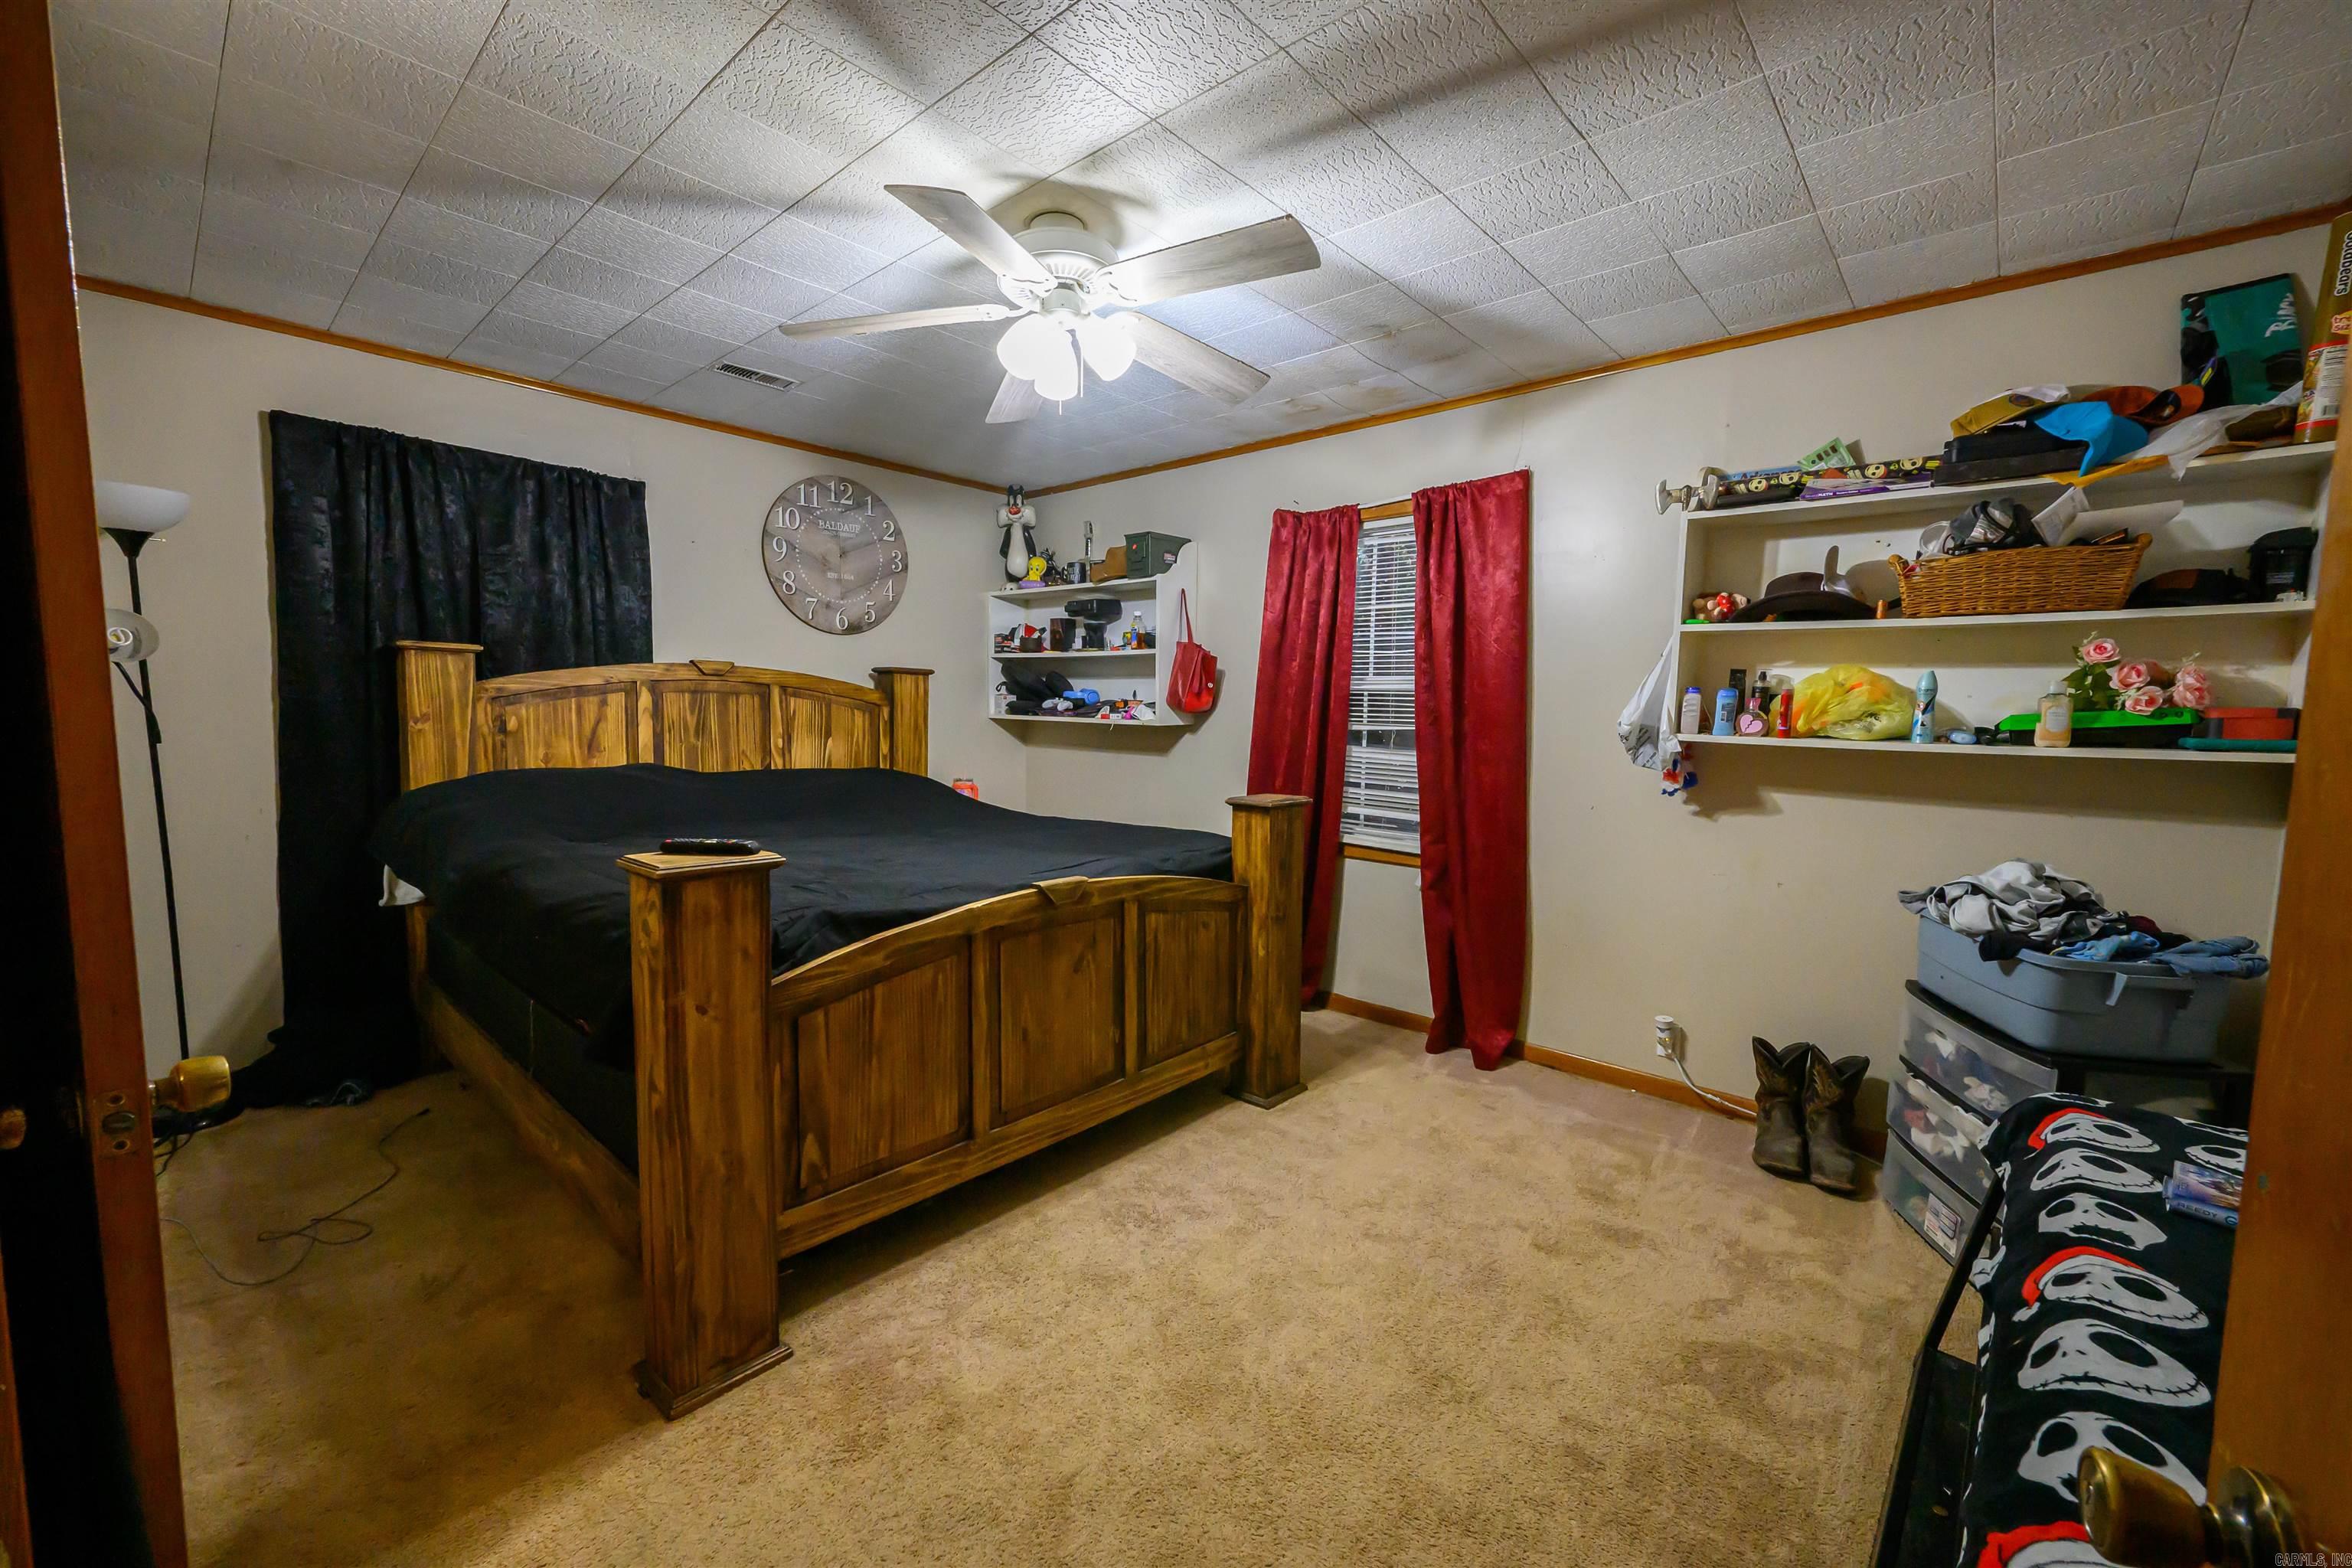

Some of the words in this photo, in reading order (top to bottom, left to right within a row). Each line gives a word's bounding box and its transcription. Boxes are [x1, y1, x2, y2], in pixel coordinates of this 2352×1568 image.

[796, 483, 822, 508] 11
[827, 480, 854, 505] 12
[864, 495, 876, 517] 1
[775, 506, 801, 530] 10
[818, 520, 861, 534] BALDAUF
[882, 520, 896, 542] 2
[773, 536, 787, 562] 9
[891, 550, 903, 573] 3
[782, 570, 796, 595] 8
[883, 579, 896, 602] 4
[805, 597, 818, 619] 7
[835, 607, 849, 631] 6
[864, 601, 877, 623] 5
